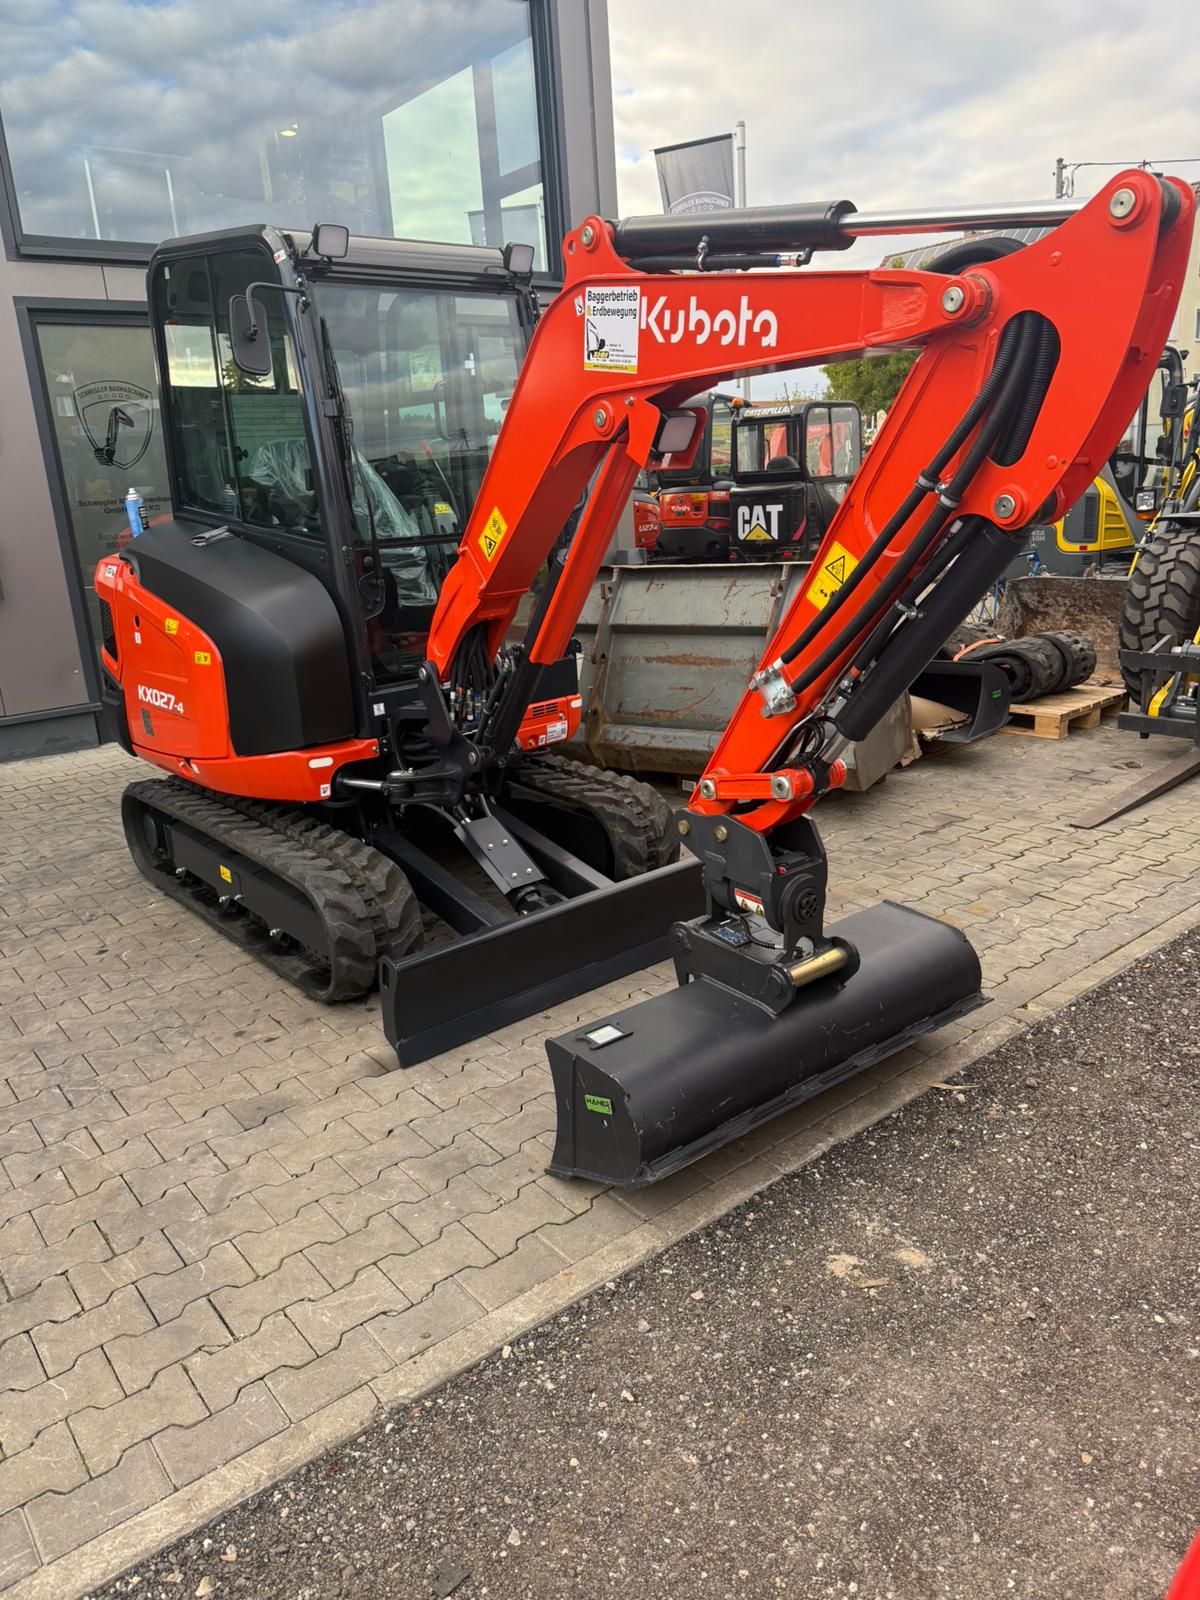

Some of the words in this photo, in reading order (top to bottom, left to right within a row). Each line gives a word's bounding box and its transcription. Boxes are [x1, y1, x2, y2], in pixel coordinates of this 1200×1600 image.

[587, 290, 638, 304] Baggerbetrieb
[592, 306, 637, 319] Erdbewegung
[640, 295, 778, 347] Kubota
[737, 504, 784, 541] CAT
[137, 684, 185, 714] KX027-4
